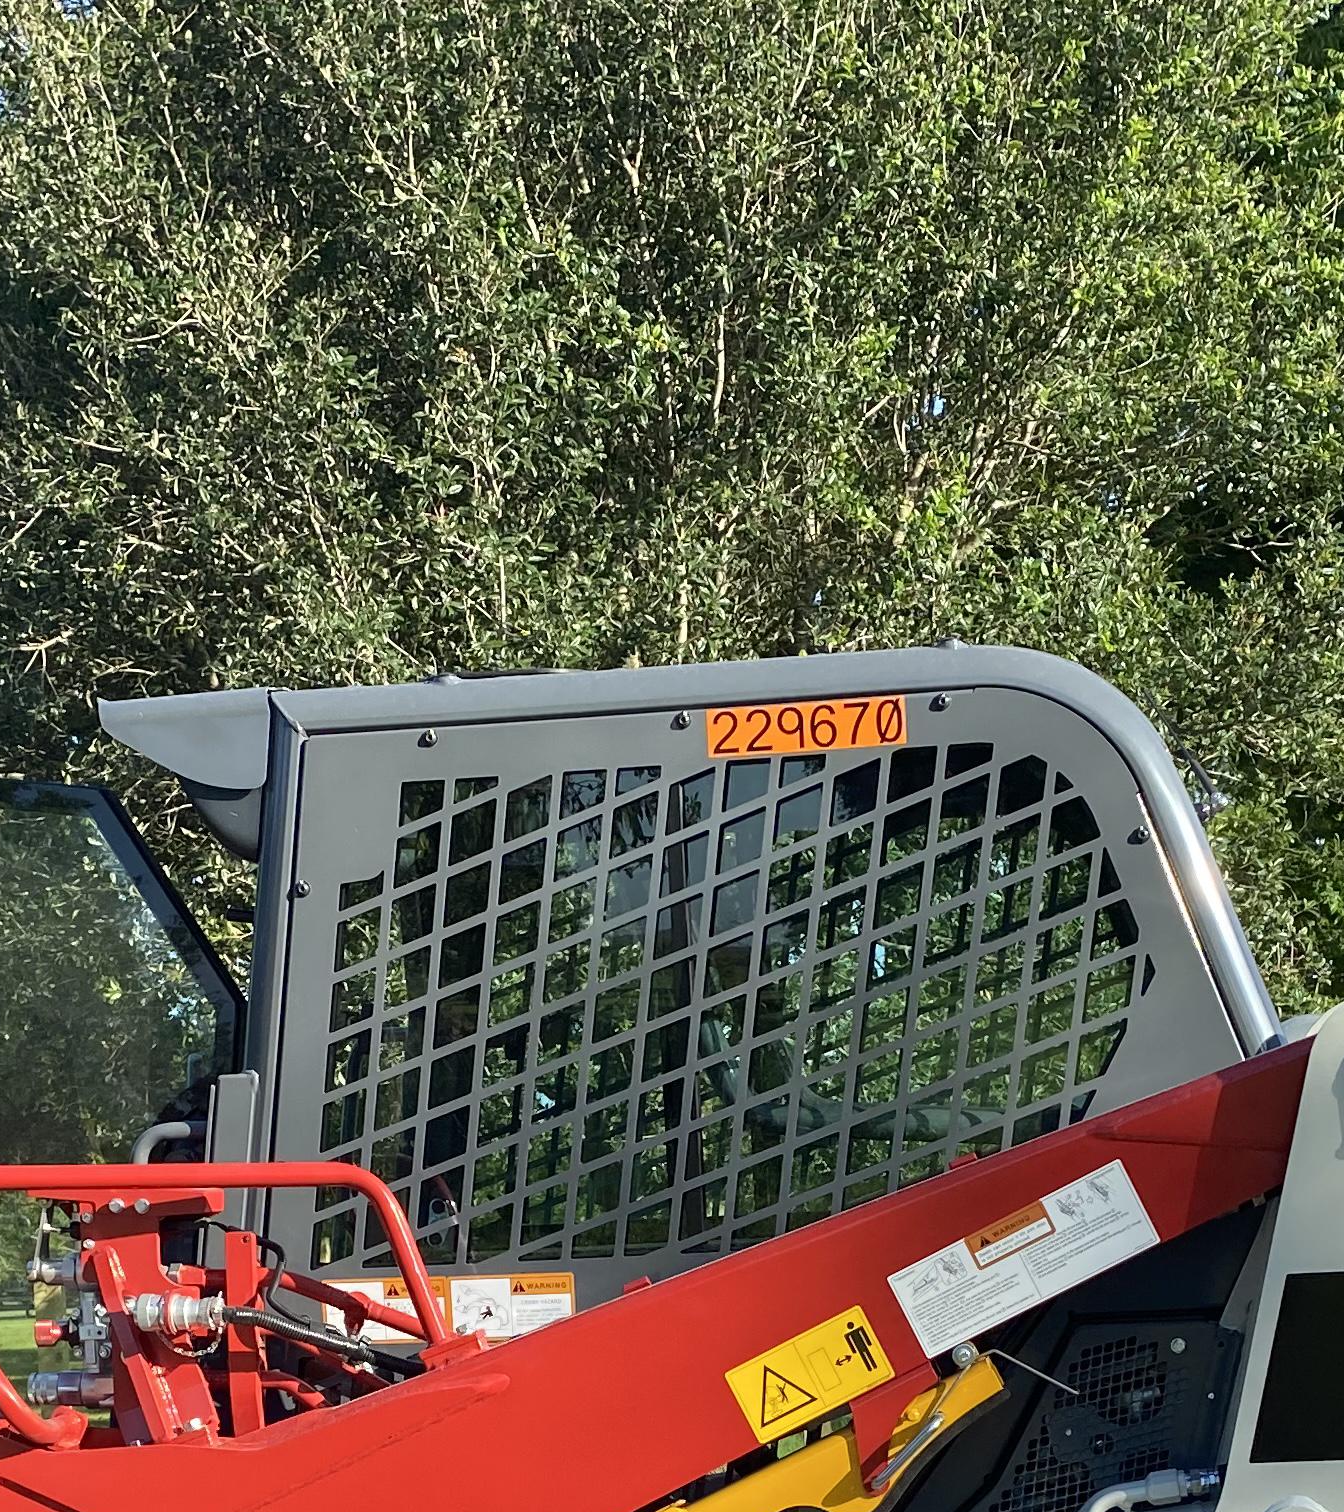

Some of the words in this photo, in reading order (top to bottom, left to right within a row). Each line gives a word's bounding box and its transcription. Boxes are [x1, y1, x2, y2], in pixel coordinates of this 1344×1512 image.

[712, 698, 903, 754] 229670
[991, 1214, 1030, 1238] WARNING
[526, 1281, 567, 1290] WARNING
